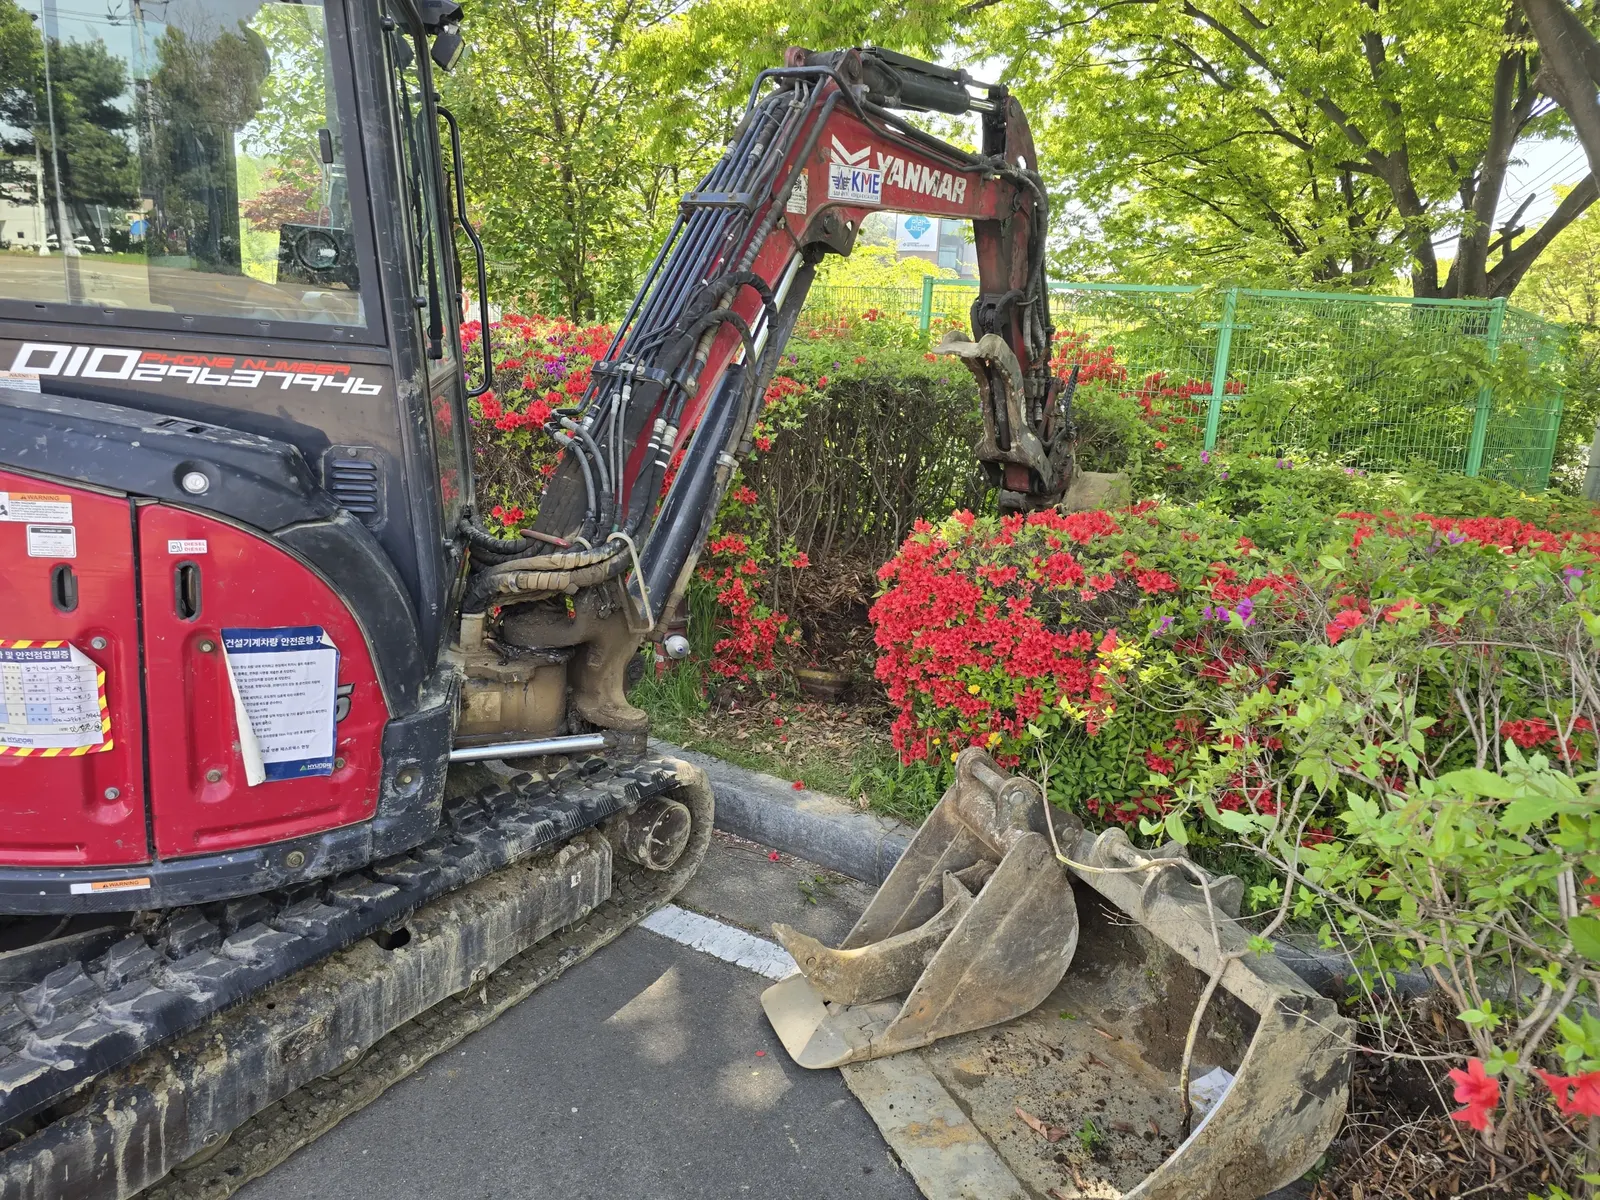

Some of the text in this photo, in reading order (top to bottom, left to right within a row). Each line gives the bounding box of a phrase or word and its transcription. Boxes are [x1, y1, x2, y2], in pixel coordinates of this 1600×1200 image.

[851, 170, 880, 194] KME
[877, 152, 967, 204] YANMAR
[10, 342, 383, 397] 010 29637946
[140, 352, 351, 376] PHONE NUMBER
[225, 638, 278, 649] 건설기계차량
[281, 636, 314, 647] 안전운행
[15, 650, 69, 660] 안전점검필증
